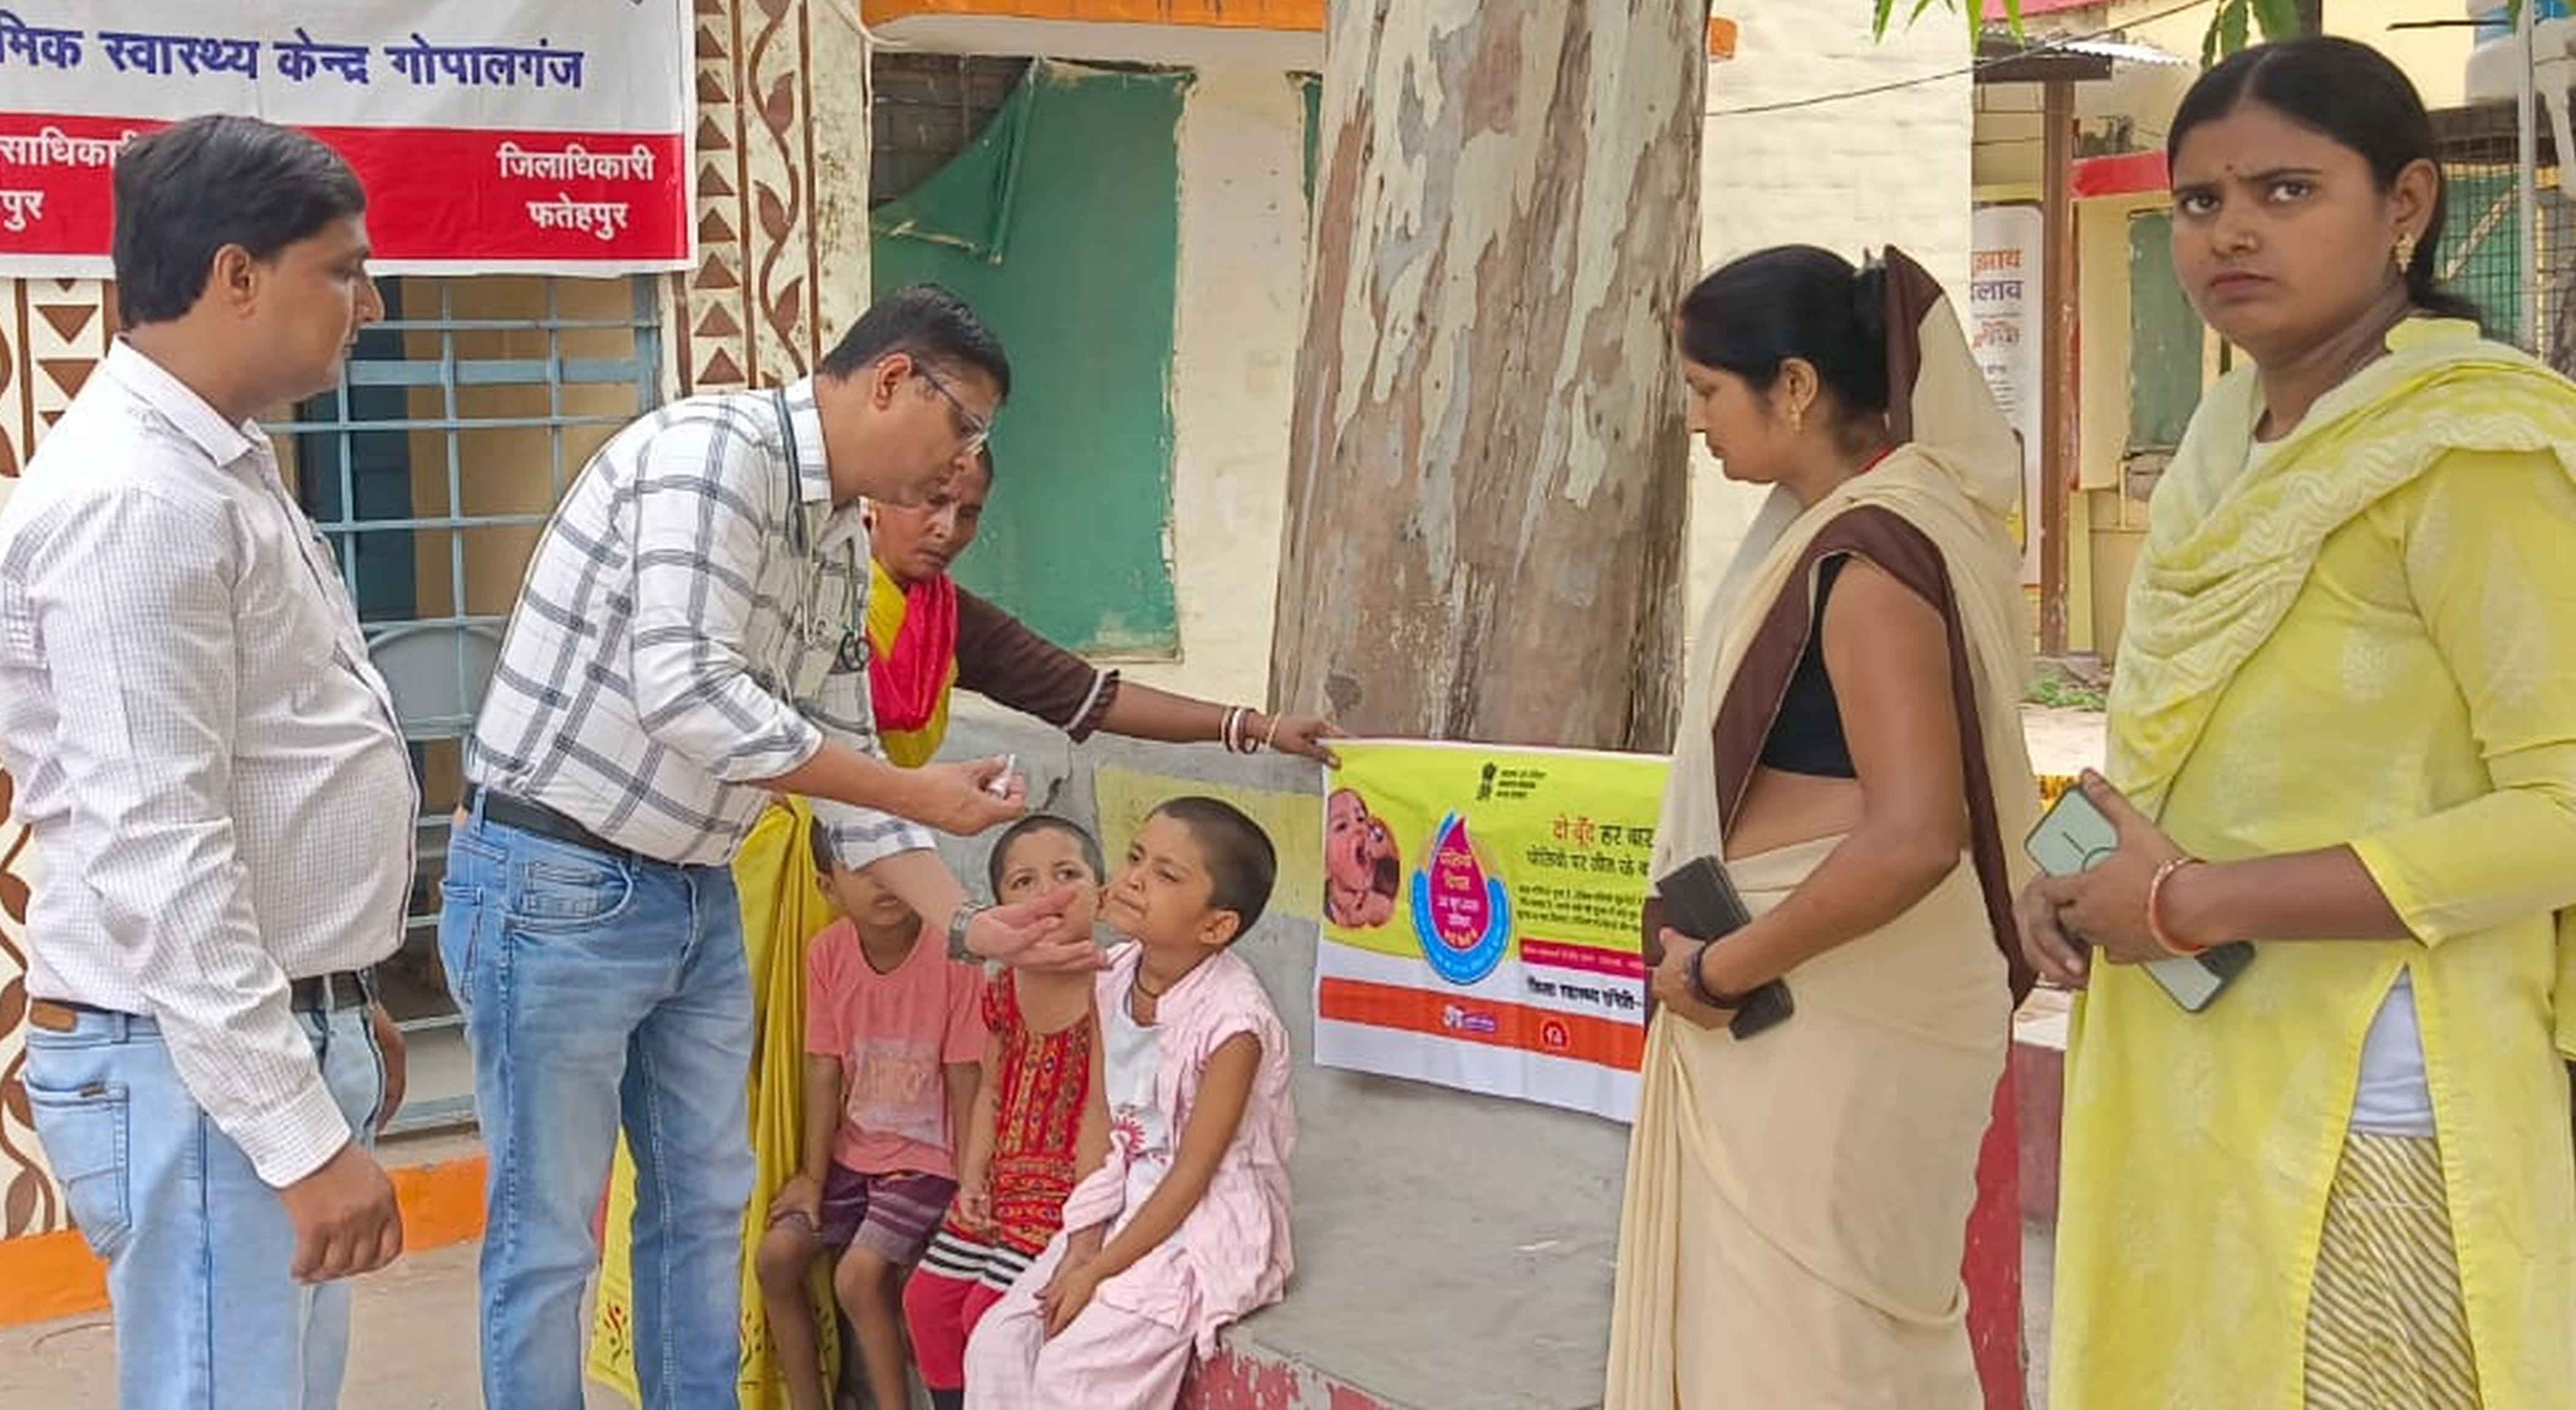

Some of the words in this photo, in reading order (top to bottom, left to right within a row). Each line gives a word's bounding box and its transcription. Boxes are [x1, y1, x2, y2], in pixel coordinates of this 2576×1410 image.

[98, 31, 259, 79] स्वास्थ्य
[274, 28, 369, 84] केन्द्र
[384, 33, 584, 88] गोपालगंज
[496, 142, 655, 180] जिलाधिकारी
[526, 193, 629, 240] फतेहपुर
[1598, 826, 1621, 846] हर
[1570, 855, 1588, 872] पर
